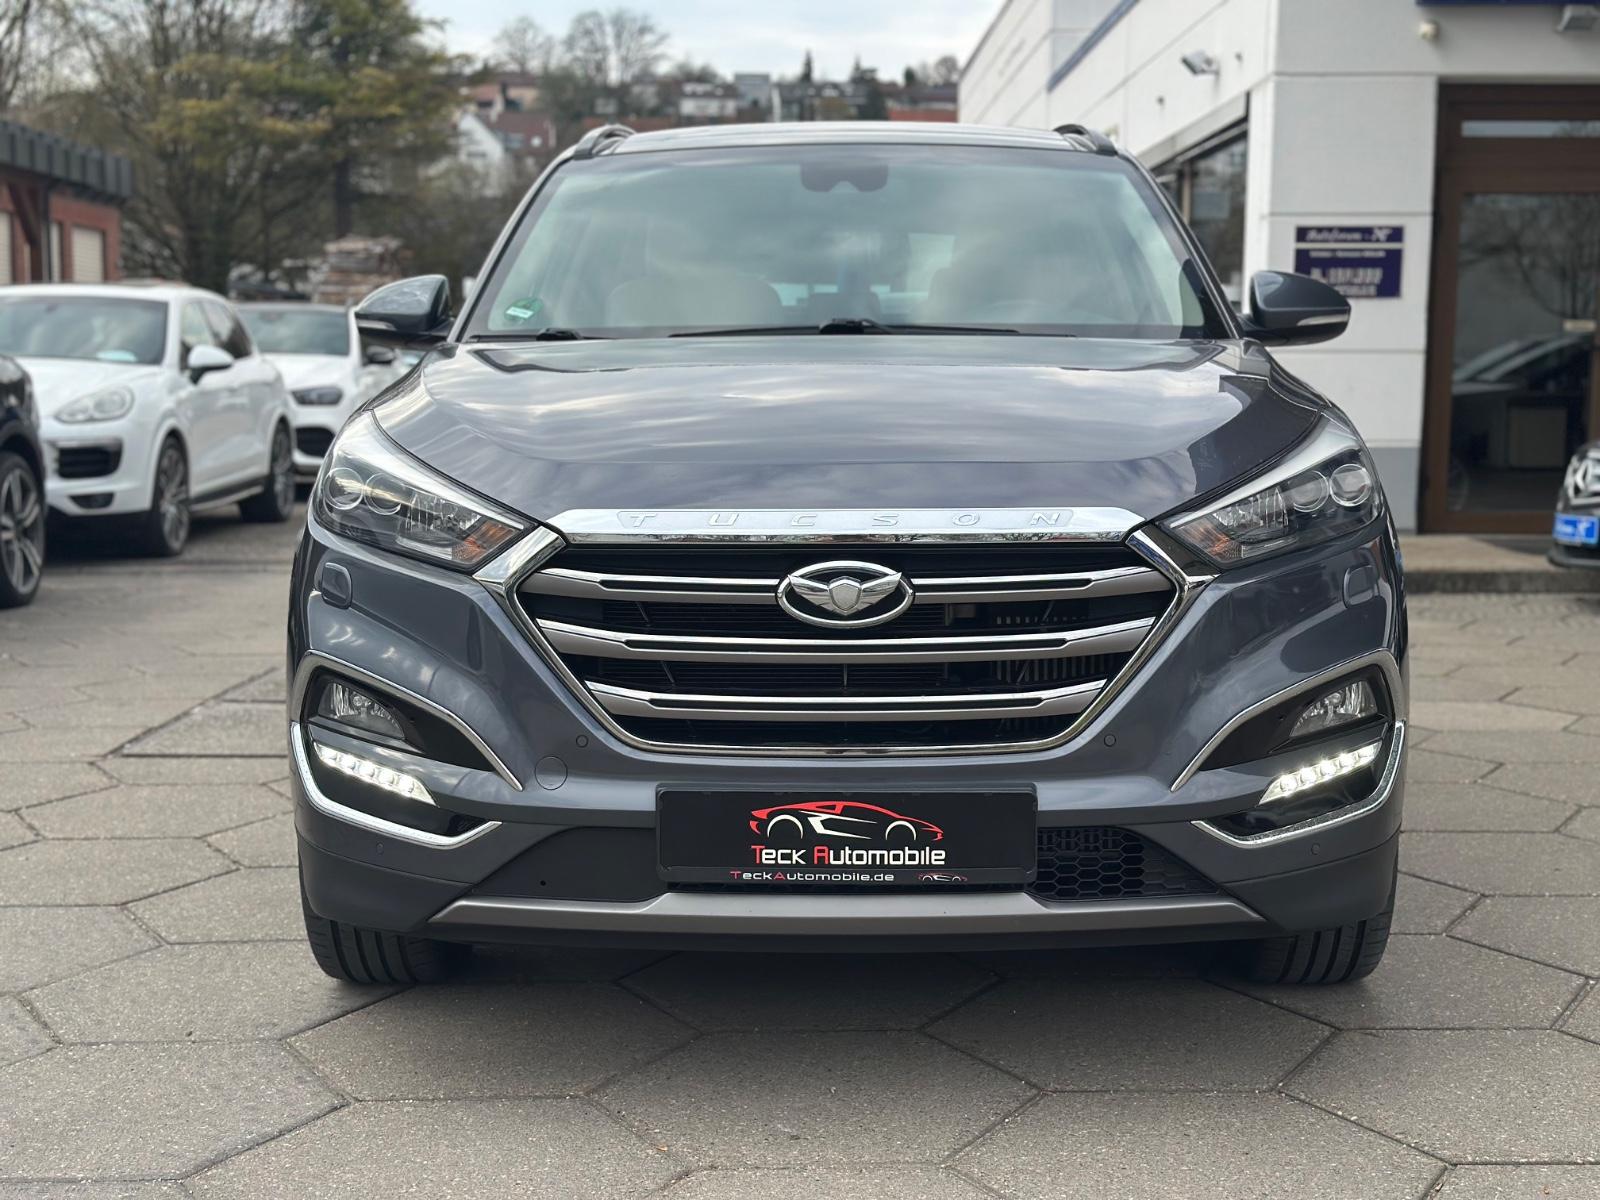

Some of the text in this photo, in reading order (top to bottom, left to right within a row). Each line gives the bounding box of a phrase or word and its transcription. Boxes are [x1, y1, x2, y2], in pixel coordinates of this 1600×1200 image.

[630, 512, 1061, 527] TUCSON
[751, 846, 946, 865] Teck Automobile
[730, 871, 894, 881] TeckAutomobile.de
